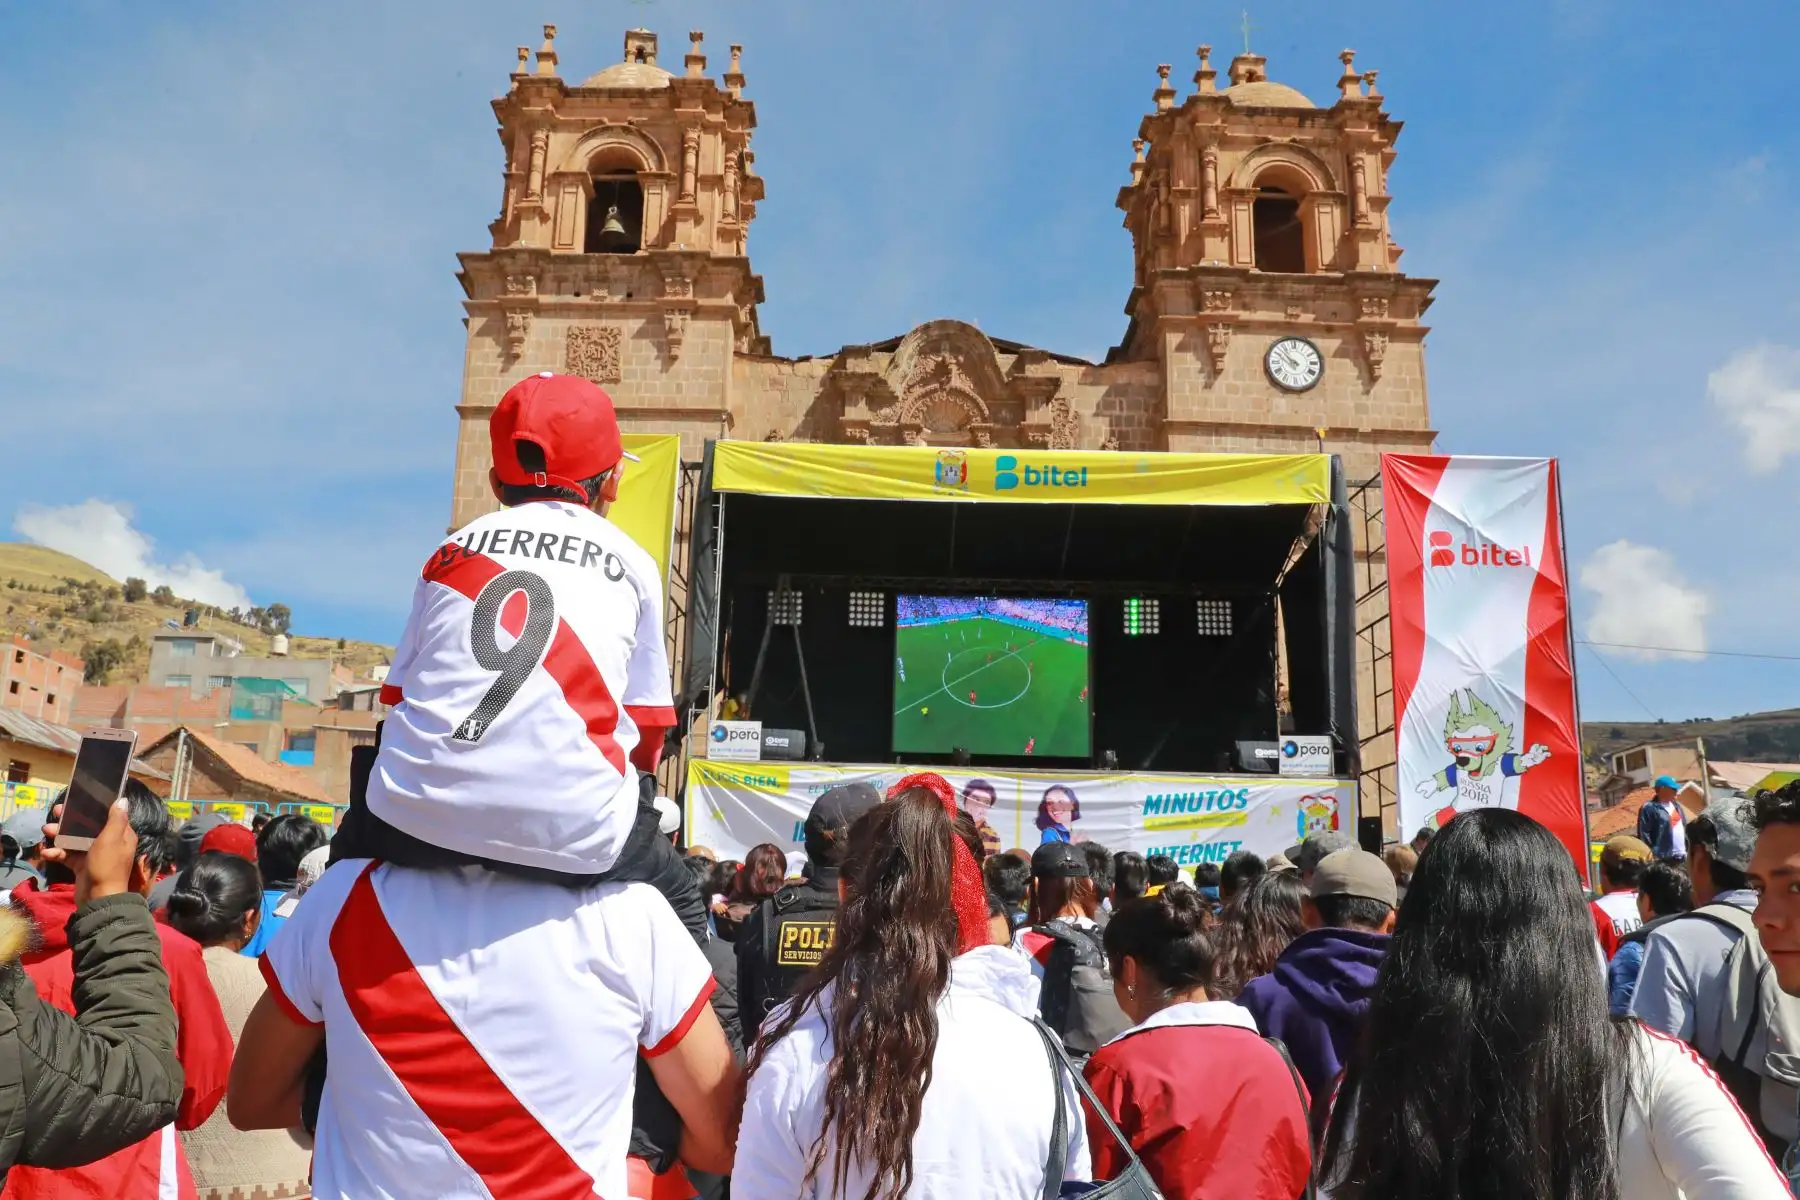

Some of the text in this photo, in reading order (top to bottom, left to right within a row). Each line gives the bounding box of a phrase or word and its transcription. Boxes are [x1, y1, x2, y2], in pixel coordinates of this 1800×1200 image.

[1024, 464, 1088, 487] bitel
[1461, 543, 1531, 567] bitel
[451, 570, 555, 742] 9
[1142, 788, 1249, 816] MINUTOS
[1461, 786, 1489, 805] 2018
[783, 927, 835, 948] POLI
